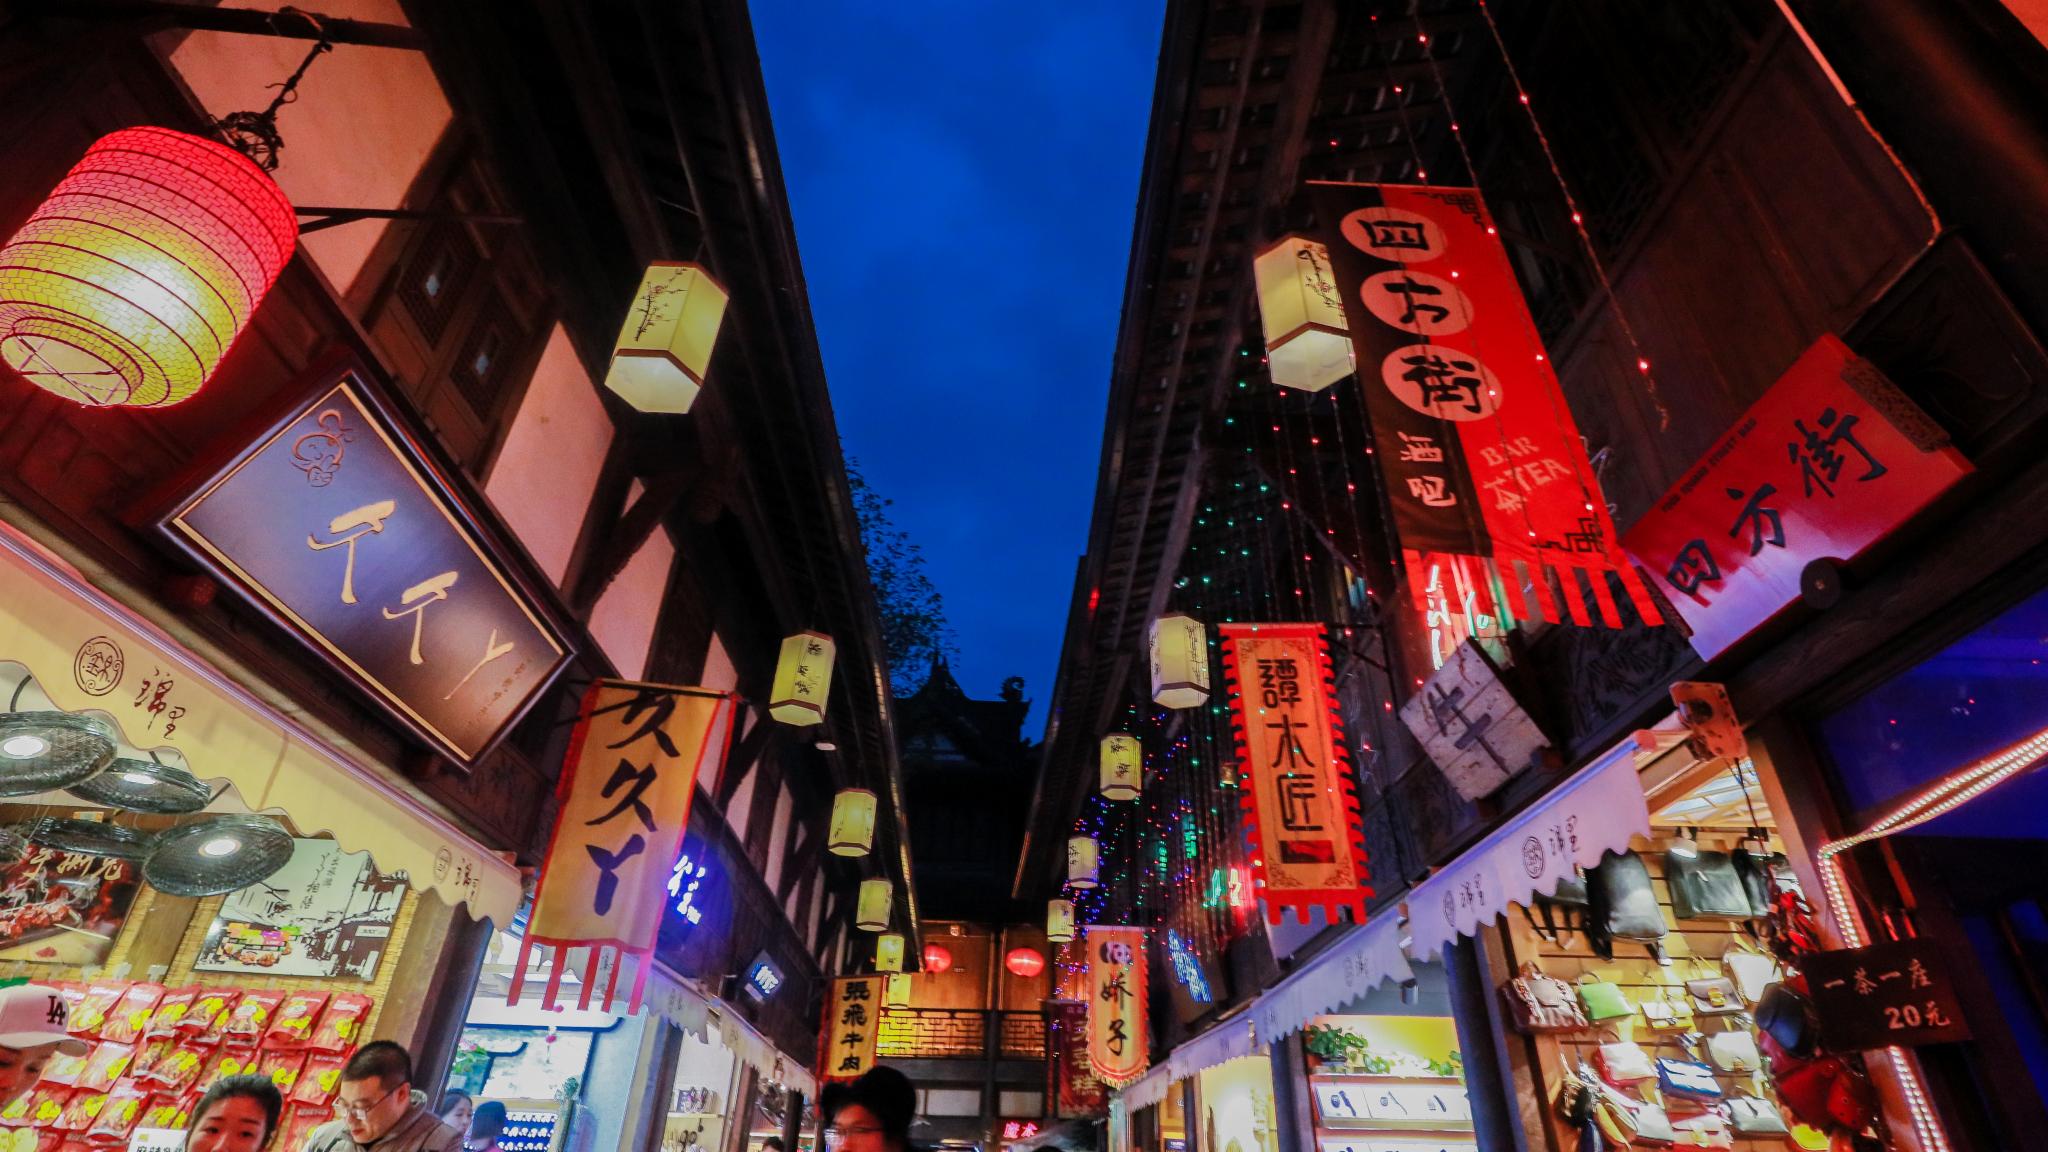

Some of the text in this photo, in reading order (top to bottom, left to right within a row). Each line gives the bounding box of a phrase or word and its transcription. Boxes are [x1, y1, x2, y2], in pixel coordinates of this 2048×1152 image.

[1356, 219, 1484, 415] 四方街
[1397, 430, 1457, 508] 酒吧
[1479, 435, 1541, 467] BAR
[1664, 406, 1889, 597] 四方街
[584, 691, 681, 918] 久久丫
[1824, 957, 1933, 996] 一茶一座
[46, 995, 66, 1026] LA
[1884, 1001, 1951, 1031] 20元
